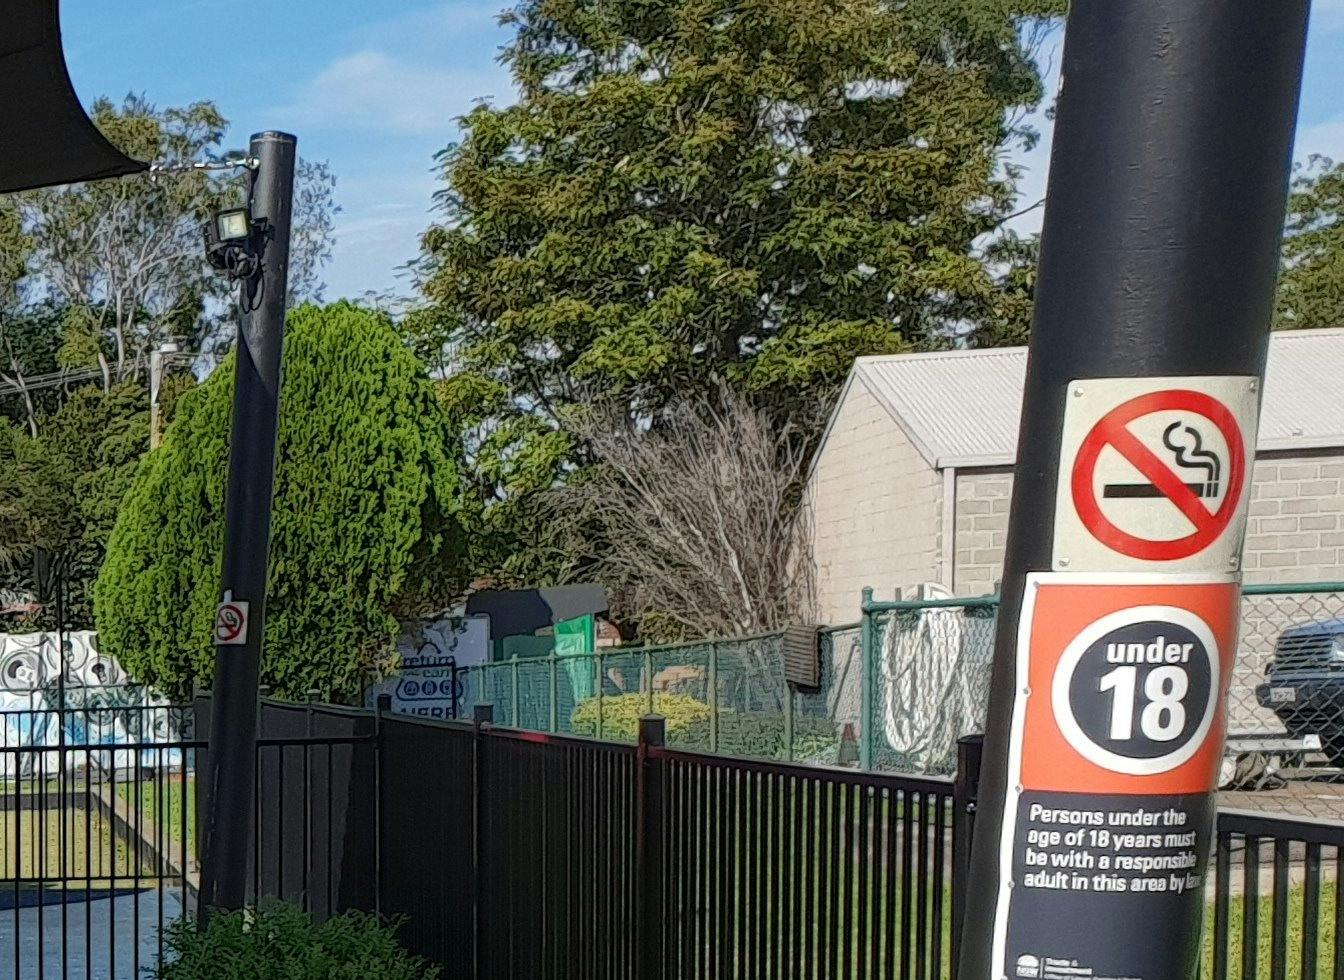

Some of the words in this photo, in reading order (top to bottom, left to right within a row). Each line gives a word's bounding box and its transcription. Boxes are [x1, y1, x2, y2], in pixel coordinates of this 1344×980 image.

[1107, 636, 1193, 663] under
[1100, 666, 1188, 741] 18
[1029, 803, 1104, 826] Persons
[1108, 808, 1162, 827] under
[1163, 808, 1187, 827] the
[1027, 829, 1061, 848] age
[1064, 828, 1086, 847] of
[1089, 829, 1111, 848] 18
[1112, 833, 1162, 851] years
[1164, 831, 1196, 848] must
[1025, 847, 1048, 866] be
[1051, 849, 1095, 869] with
[1098, 855, 1111, 870] a
[1114, 851, 1197, 873] responsible
[1024, 869, 1070, 890] adult
[1072, 871, 1088, 890] in
[1092, 873, 1127, 892] this
[1130, 879, 1167, 892] area
[1169, 875, 1185, 894] by
